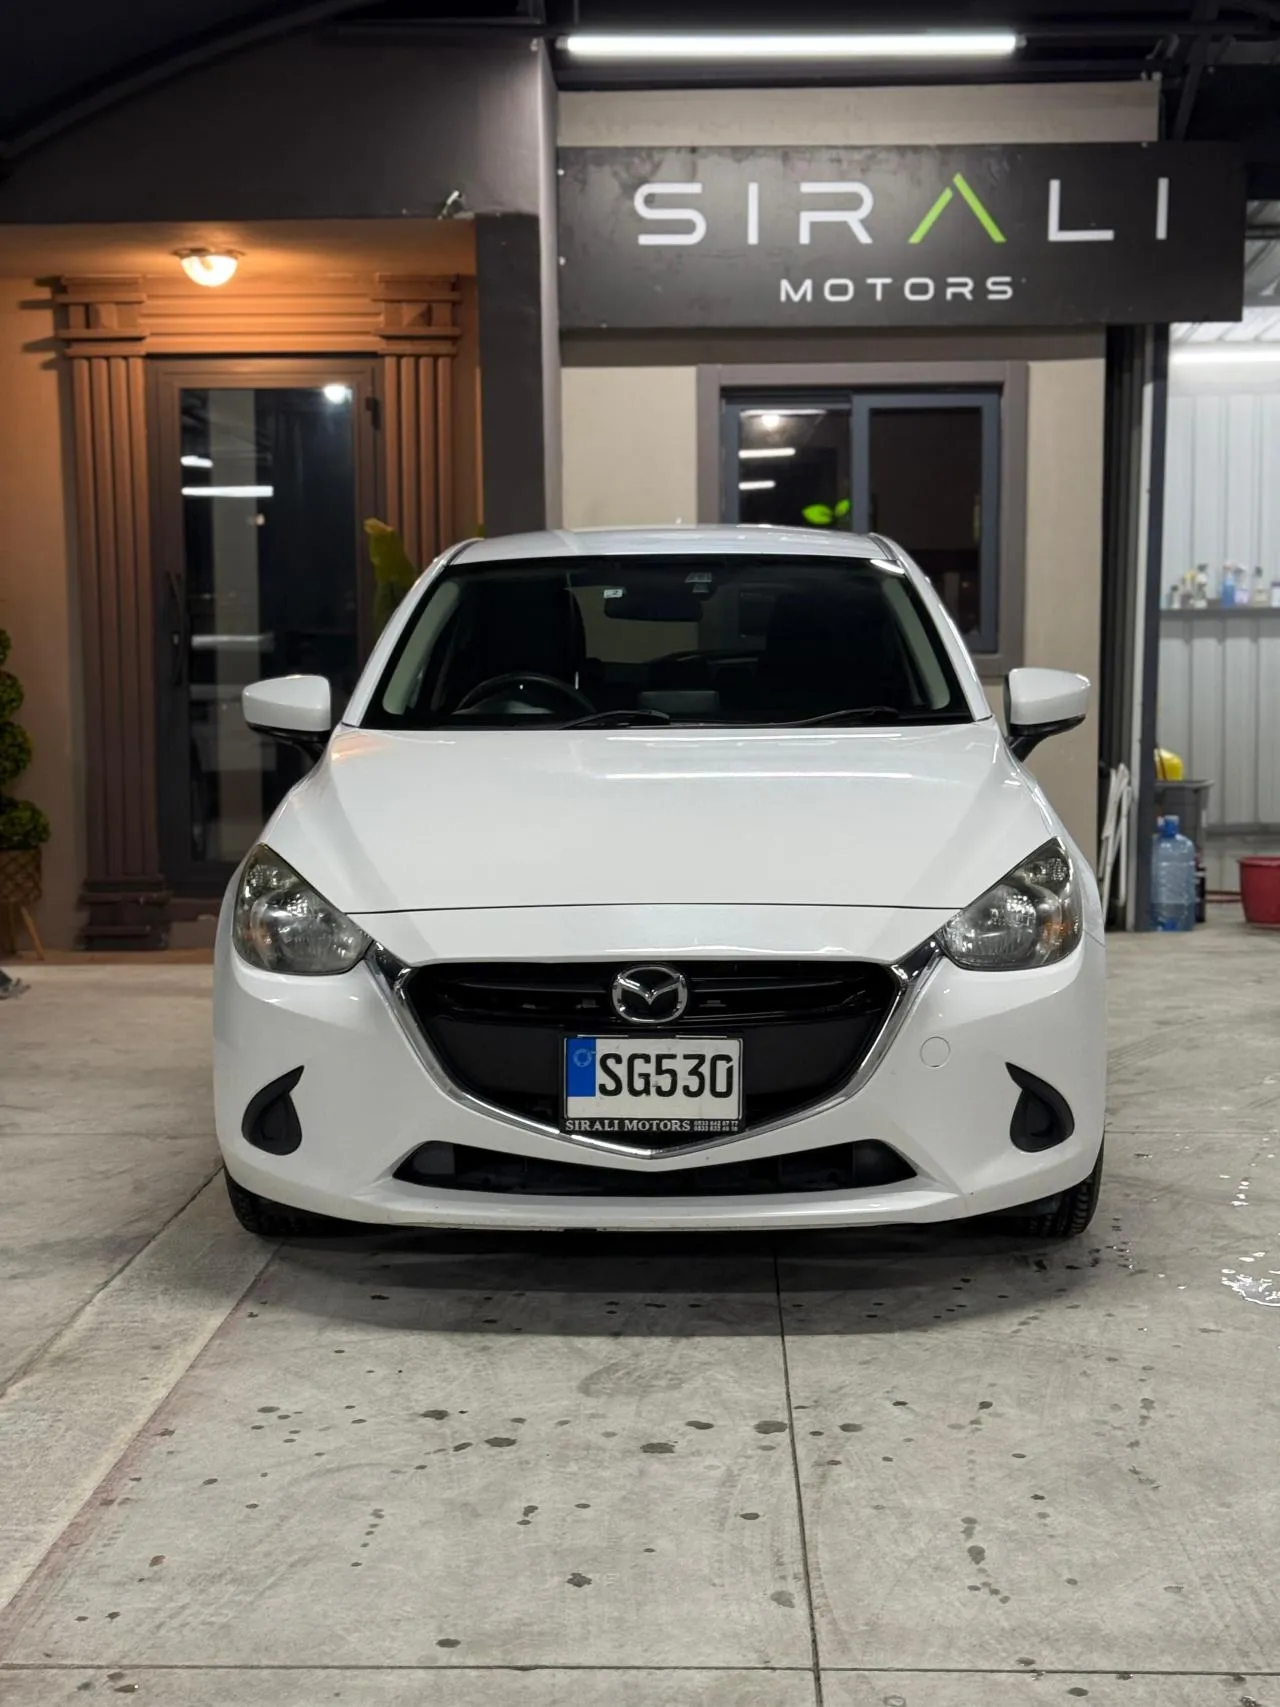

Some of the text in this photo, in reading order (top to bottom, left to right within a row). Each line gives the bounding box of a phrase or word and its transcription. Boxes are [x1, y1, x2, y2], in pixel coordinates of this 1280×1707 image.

[633, 173, 1169, 245] SIRALI
[780, 276, 1014, 302] MOTORS
[598, 1052, 734, 1098] SG530
[565, 1119, 691, 1132] SIRALI MOTORS
